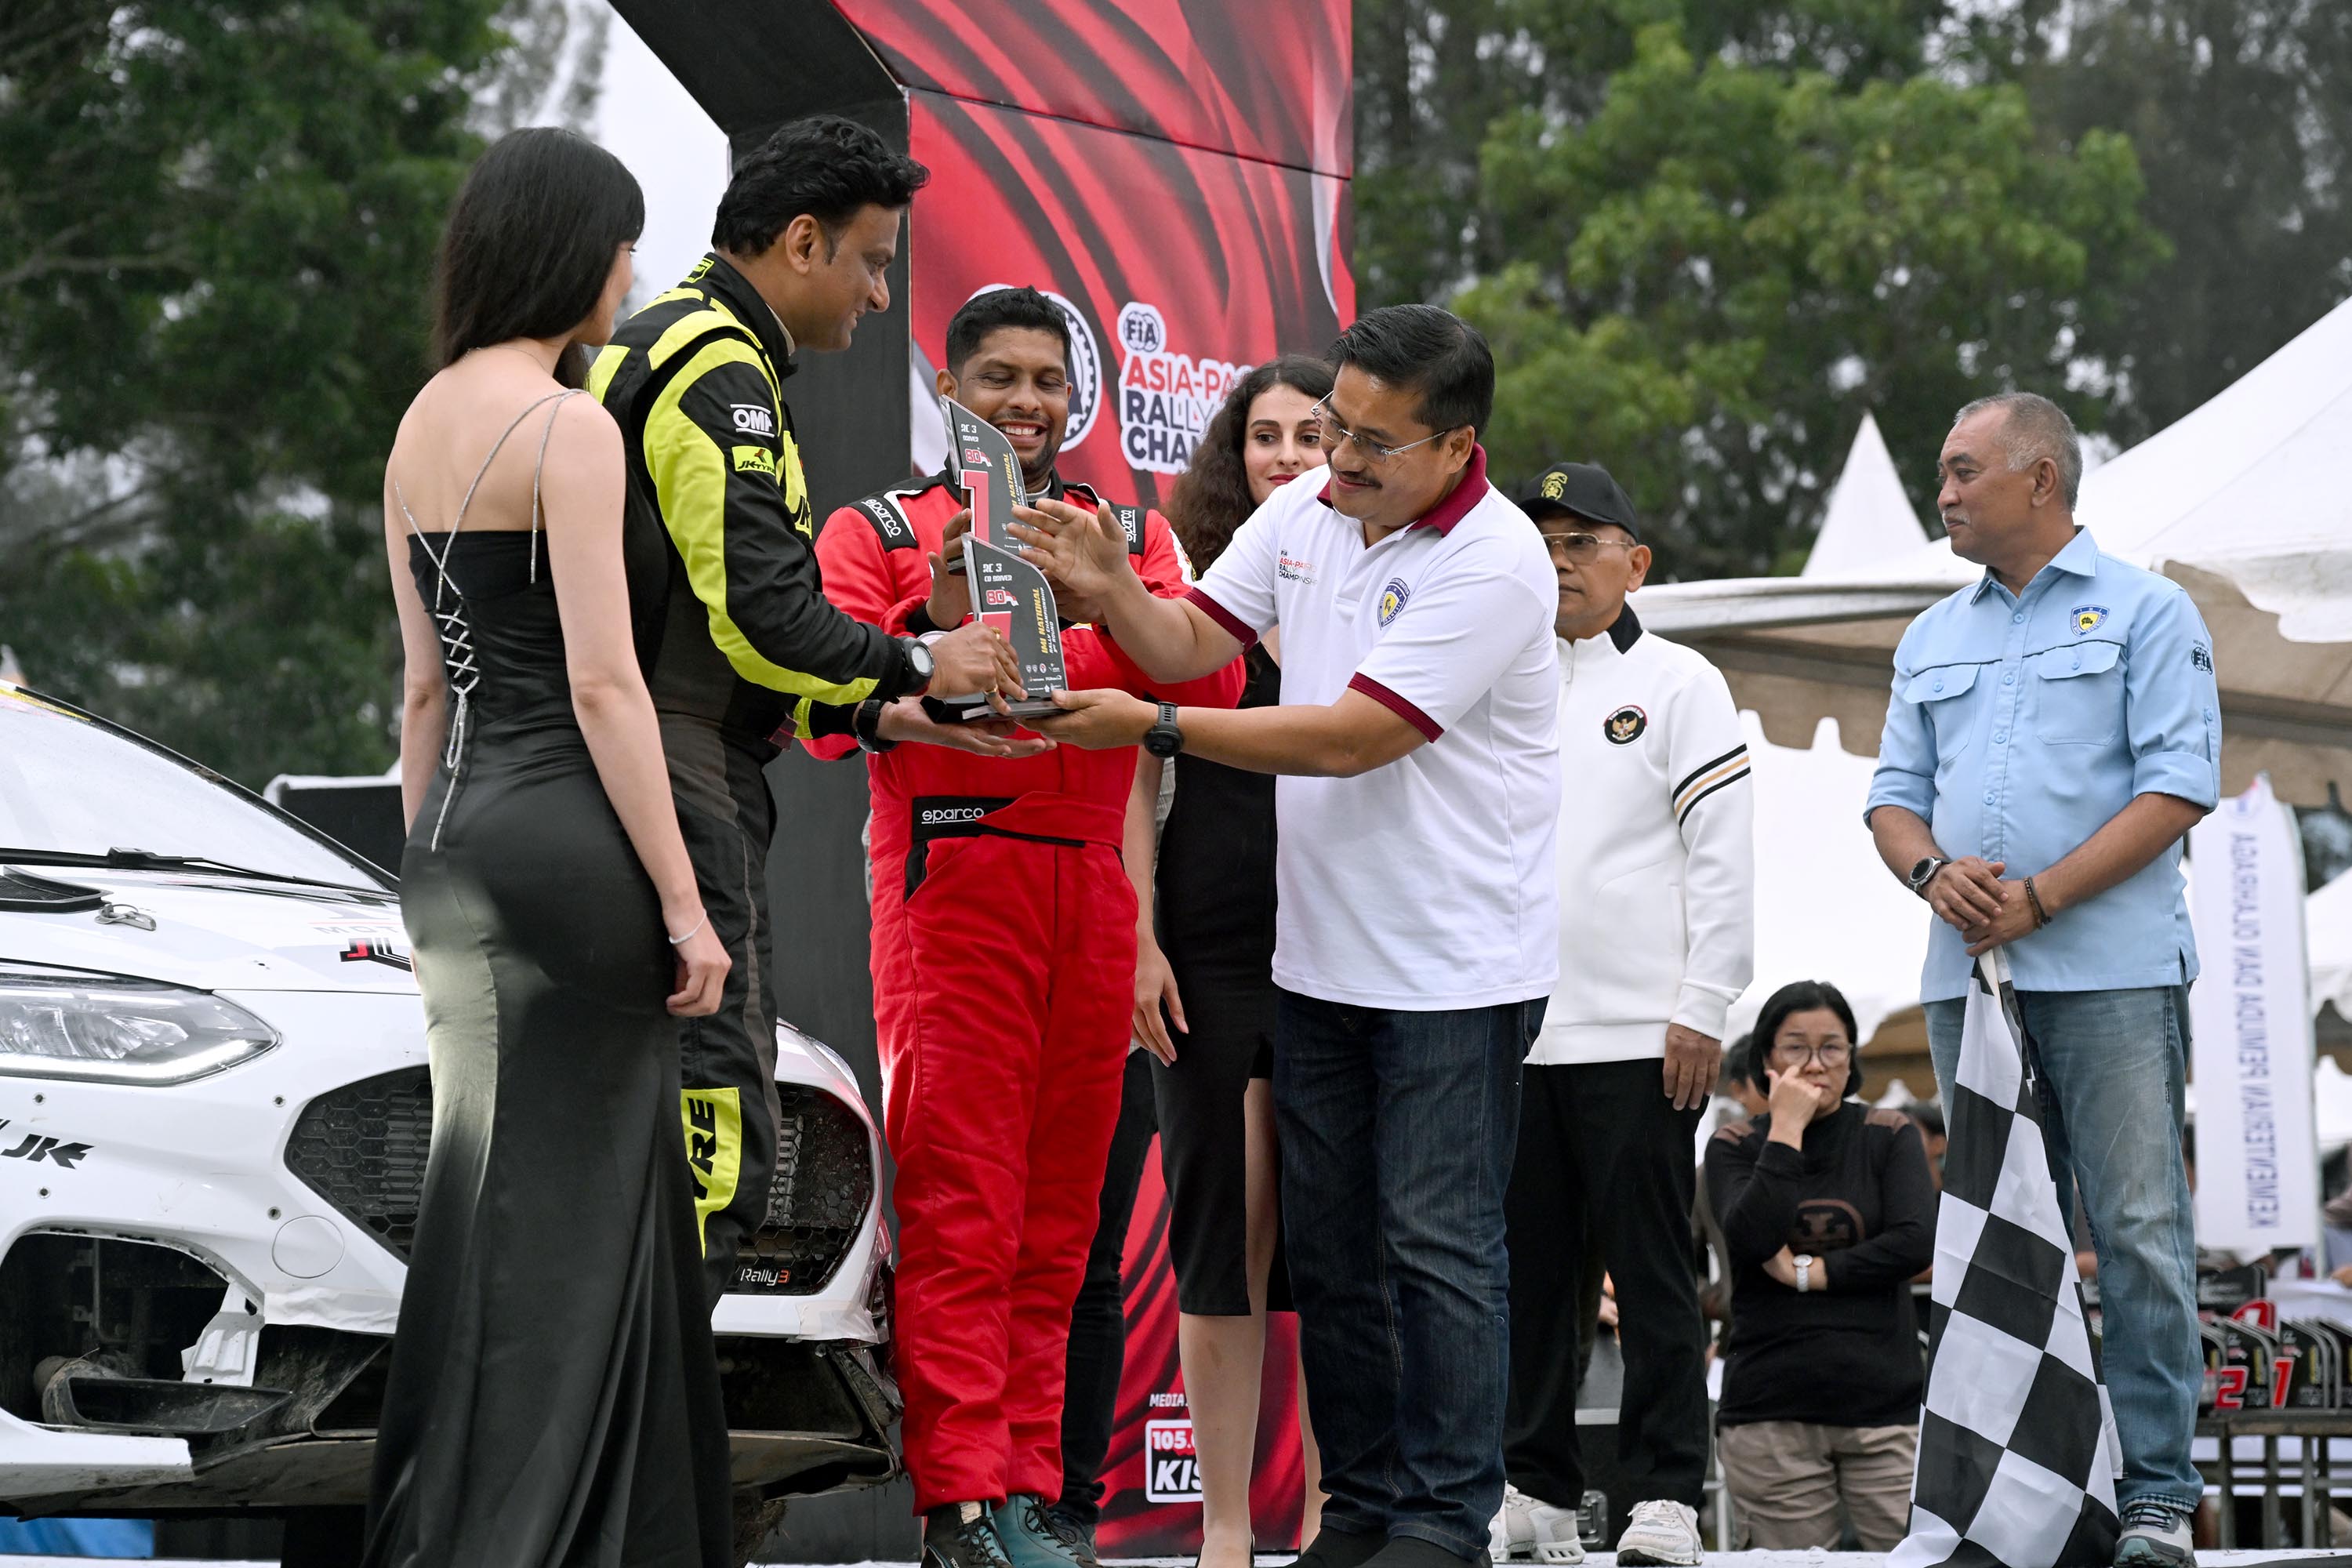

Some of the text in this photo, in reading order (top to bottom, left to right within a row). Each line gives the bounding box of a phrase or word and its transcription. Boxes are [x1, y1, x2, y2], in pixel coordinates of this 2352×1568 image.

[1125, 355, 1243, 402] ASIA-PA
[732, 408, 772, 432] OMP
[1126, 390, 1215, 433] RALLY
[971, 425, 977, 434] 3
[864, 499, 902, 537] sparco
[995, 563, 1003, 572] 3
[1033, 588, 1049, 654] IMI NATIONAL
[921, 808, 985, 824] sparco
[740, 1268, 790, 1286] Rally3
[2271, 1357, 2296, 1409] 1
[1149, 1393, 1185, 1407] MEDIA
